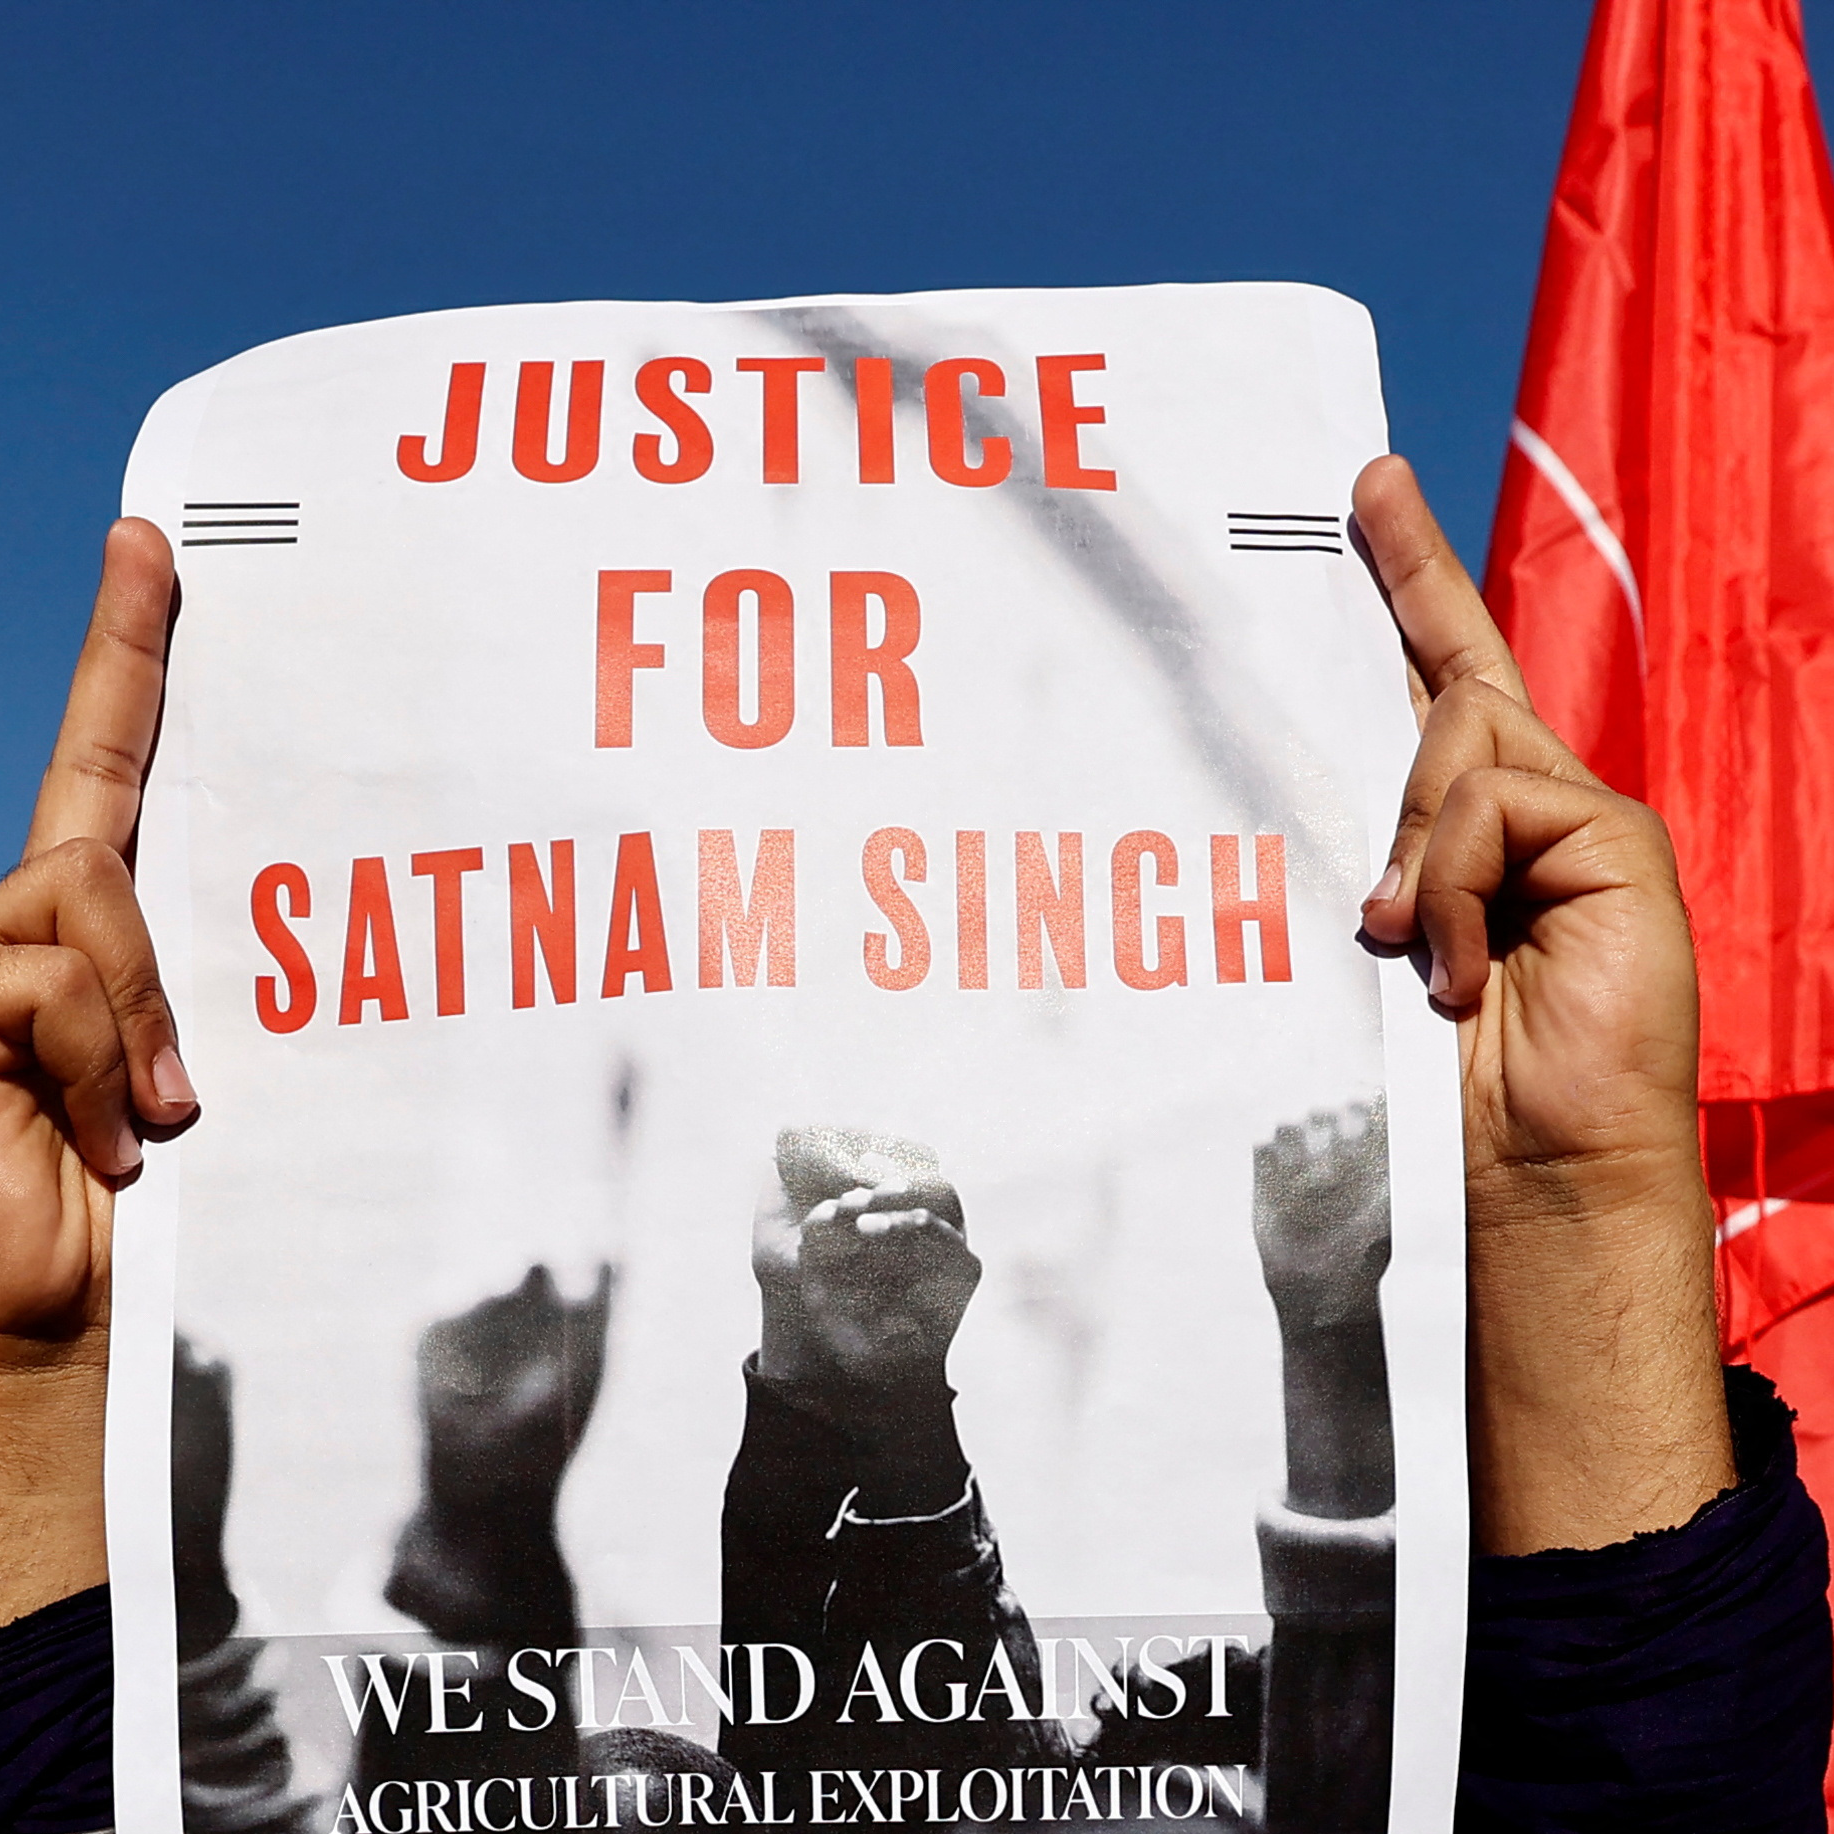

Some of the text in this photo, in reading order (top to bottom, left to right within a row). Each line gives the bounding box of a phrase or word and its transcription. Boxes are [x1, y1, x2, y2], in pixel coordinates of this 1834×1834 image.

[396, 353, 1118, 492] JUSTICE
[596, 568, 924, 750] FOR
[250, 827, 1294, 1036] SATNAM SINGH
[320, 1634, 1250, 1737] WE STAND AGAINST
[808, 1764, 1247, 1824] EXPLOITATION
